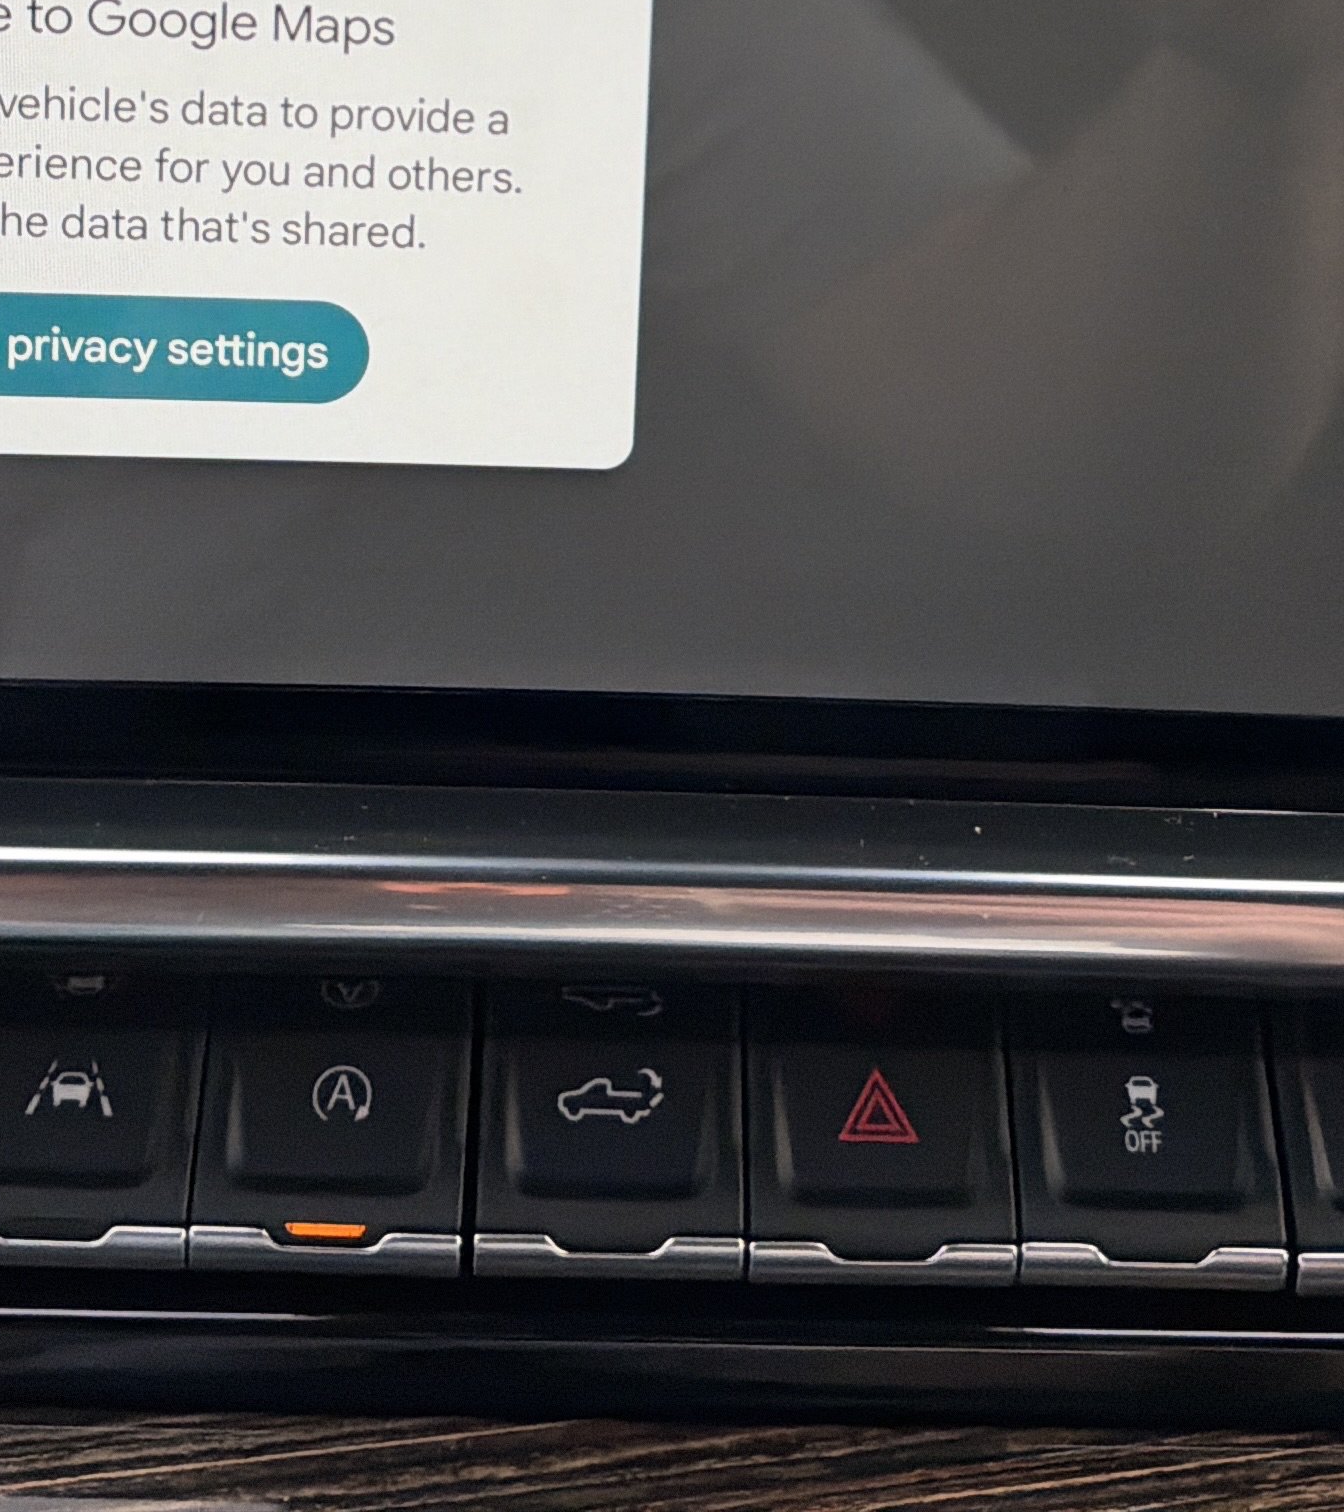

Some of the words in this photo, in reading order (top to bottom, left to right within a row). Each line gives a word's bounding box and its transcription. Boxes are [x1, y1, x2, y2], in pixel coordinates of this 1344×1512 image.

[273, 3, 395, 55] Maps
[181, 89, 267, 128] data
[280, 97, 318, 129] to
[330, 97, 475, 139] provide
[487, 110, 509, 136] a
[154, 146, 210, 184] for
[221, 159, 290, 194] you
[304, 154, 376, 190] and
[388, 156, 522, 194] others.
[61, 203, 148, 241] data
[160, 206, 271, 244] that's
[282, 210, 426, 249] shared.
[7, 325, 158, 373] privacy
[167, 330, 329, 378] settings
[1124, 1129, 1162, 1153] OFF
